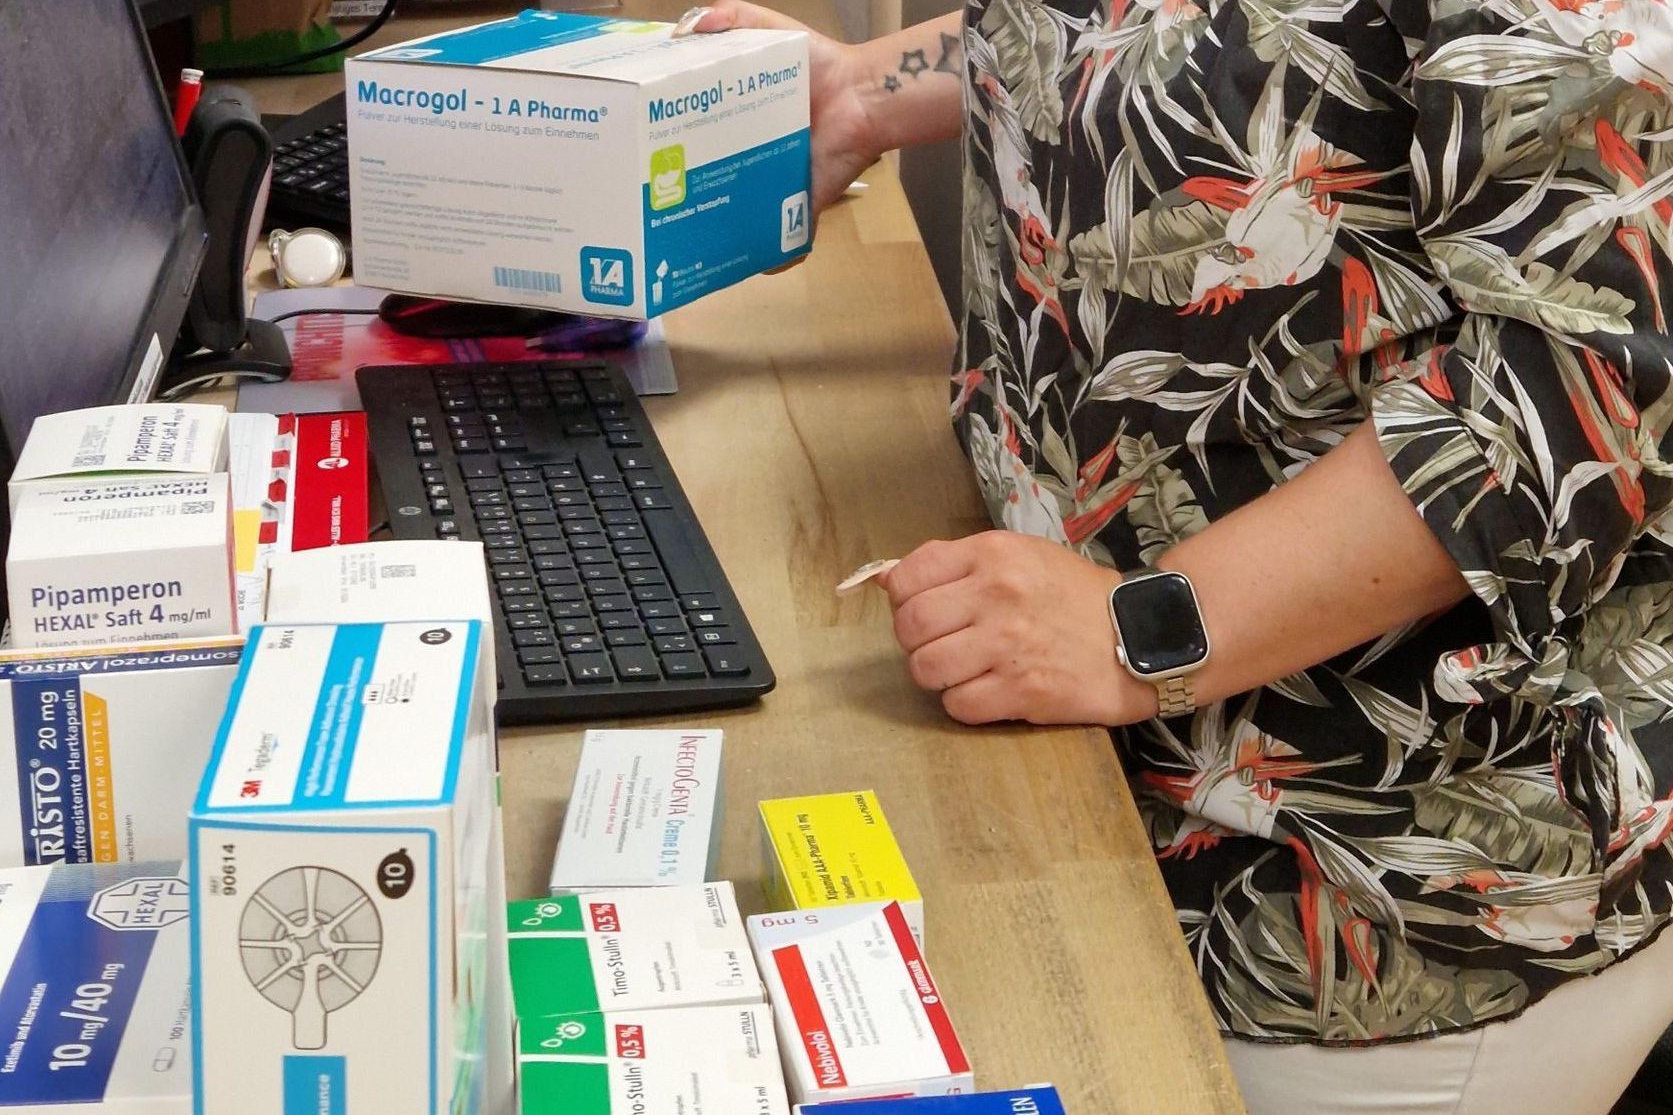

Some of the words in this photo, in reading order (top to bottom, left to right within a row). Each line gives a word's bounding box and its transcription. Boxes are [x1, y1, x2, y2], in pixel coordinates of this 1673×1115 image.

[358, 80, 467, 115] Macrogol
[492, 97, 502, 115] 1
[508, 98, 521, 116] A
[527, 99, 609, 123] Pharma®
[649, 80, 723, 124] Macrogol
[737, 79, 744, 96] 1
[747, 76, 756, 94] A
[358, 110, 385, 122] Pulver
[387, 114, 402, 124] zur
[404, 114, 456, 130] Herstellung
[459, 119, 482, 131] einer
[485, 121, 520, 136] Lösung
[522, 126, 545, 136] zum
[545, 126, 600, 141] Einnehmen
[651, 218, 662, 228] Bei
[127, 415, 158, 463] Pipamperon
[63, 487, 208, 503] Pipamperon
[31, 580, 182, 611] Pipamperon
[34, 613, 99, 633] HEXAL®
[105, 607, 143, 627] Saft
[149, 604, 164, 624] 4
[169, 609, 212, 625] mg/ml
[426, 631, 445, 642] 10
[102, 650, 242, 671] someprazol
[42, 692, 60, 721] mg
[38, 727, 57, 750] 20
[62, 689, 81, 771] Hartkapseln
[240, 779, 263, 798] 3M
[663, 819, 685, 847] Creme
[659, 850, 680, 864] 0,1
[222, 843, 237, 897] 90614
[384, 862, 407, 889] 10
[703, 887, 718, 908] STULLN
[819, 872, 839, 900] Xipamid
[133, 883, 164, 923] HEXAL
[595, 903, 612, 915] %
[599, 916, 617, 932] 0,5
[762, 918, 796, 928] mg
[805, 915, 819, 925] 5
[49, 1044, 92, 1071] 10
[101, 963, 125, 981] mg
[740, 1011, 754, 1035] STULLN
[620, 1025, 638, 1038] %
[622, 1039, 643, 1059] 0,5
[806, 1030, 842, 1085] Nebivolol
